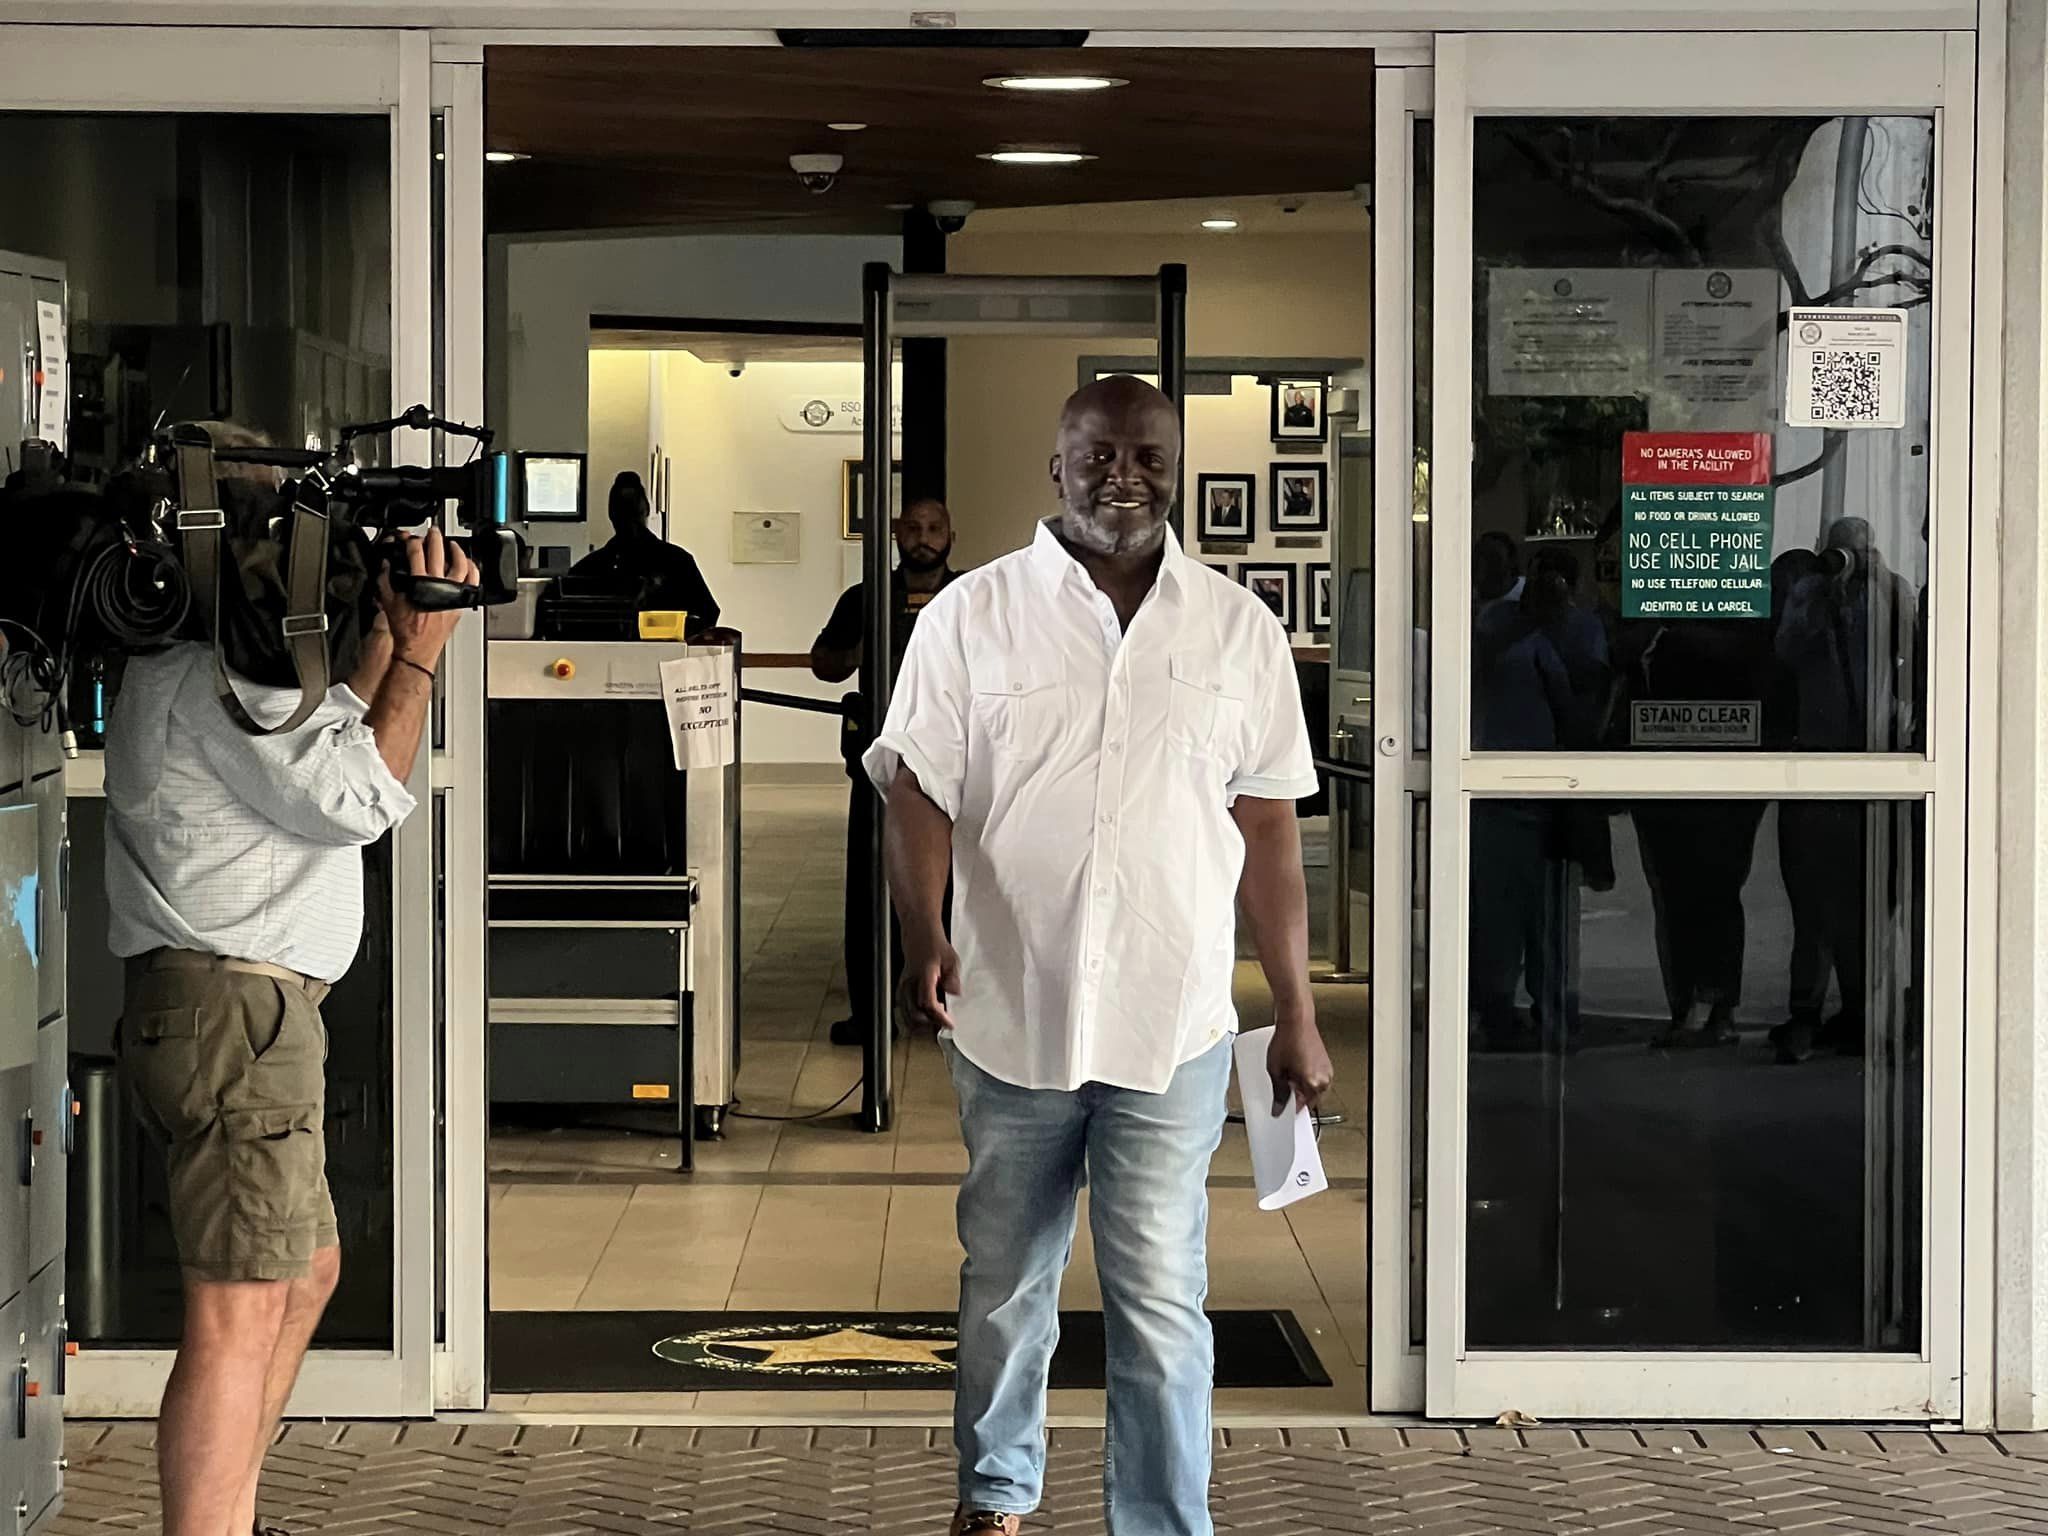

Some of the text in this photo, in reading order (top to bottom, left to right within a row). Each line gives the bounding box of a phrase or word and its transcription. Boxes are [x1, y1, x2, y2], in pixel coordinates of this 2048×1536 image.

[841, 401, 861, 413] BSO
[1640, 448, 1752, 461] NO CAMERA'S ALLOWED
[1658, 460, 1734, 472] IN THE FACILITY
[1630, 491, 1764, 501] ALL ITEMS SUBJECT TO SEARCH
[1634, 511, 1760, 522] NO FOOD OR DRINKS ALLOWED
[1629, 533, 1764, 550] NO CELL PHONE
[1629, 553, 1764, 570] USE INSIDE JAIL
[1631, 579, 1763, 590] NO USE TELEFONO CELULAR
[1640, 601, 1754, 612] ADENTRO DE LA CARCEL
[699, 706, 712, 714] NO
[1640, 707, 1751, 723] STAND CLEAR
